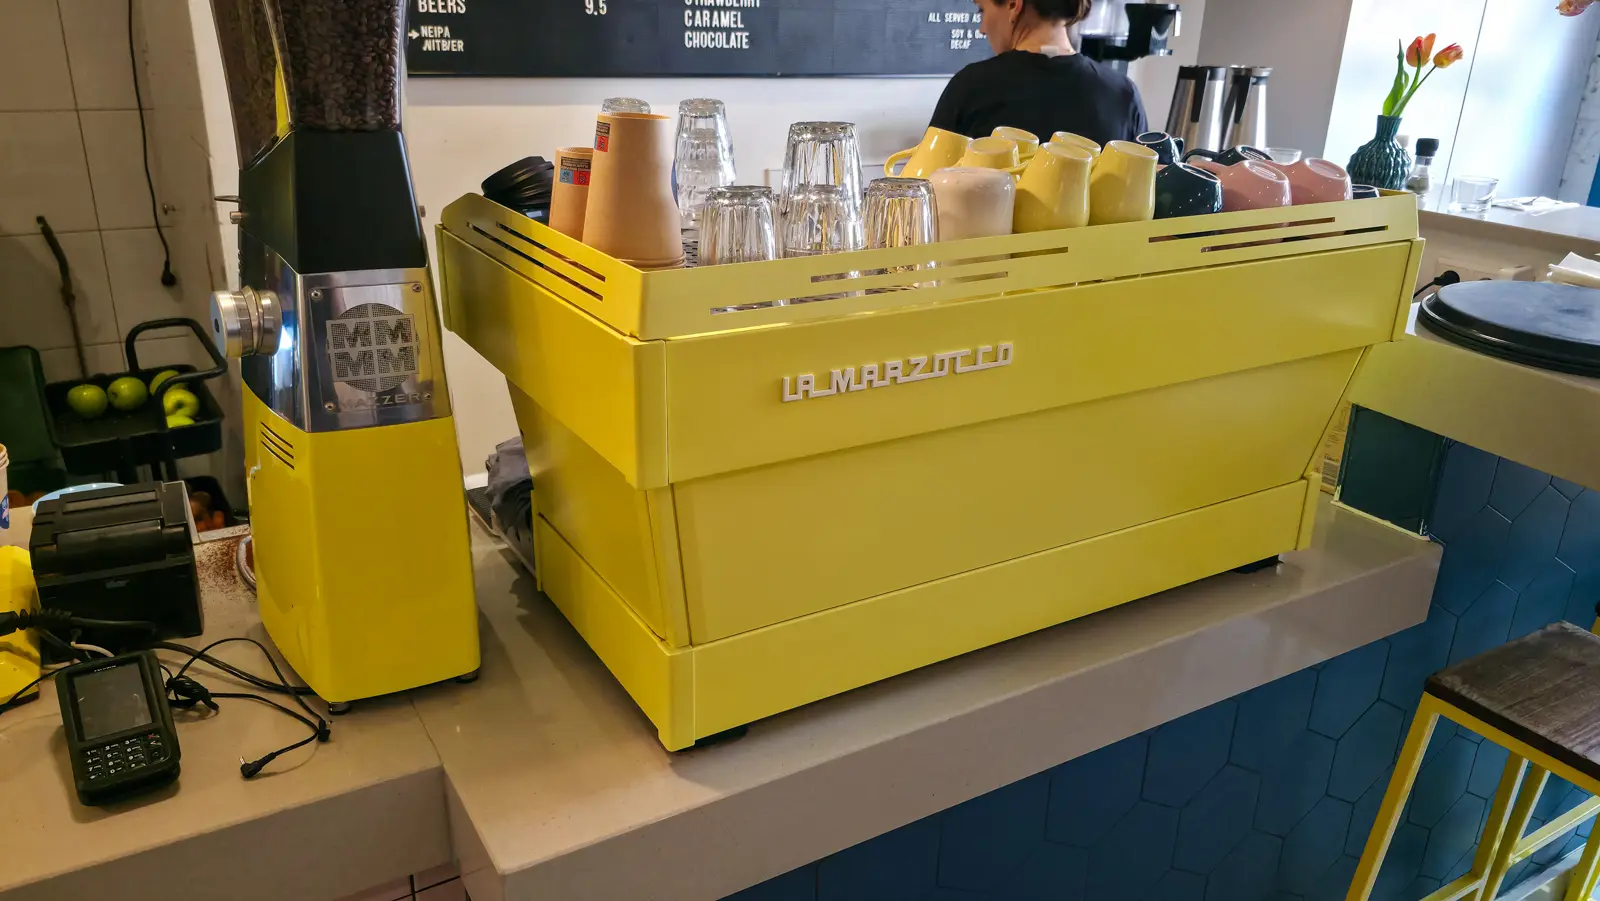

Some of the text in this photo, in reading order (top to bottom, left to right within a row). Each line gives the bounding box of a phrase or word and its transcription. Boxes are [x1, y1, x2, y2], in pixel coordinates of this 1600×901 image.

[418, 0, 466, 14] BEERS
[584, 0, 607, 15] 9.5
[684, 10, 744, 28] CARAMEL
[928, 12, 982, 23] ALL SERVED AS
[420, 25, 451, 38] NEIPA
[951, 29, 964, 39] SOY
[684, 31, 749, 49] CHOCOLATE
[950, 40, 971, 50] DECAF
[782, 374, 815, 403] LA
